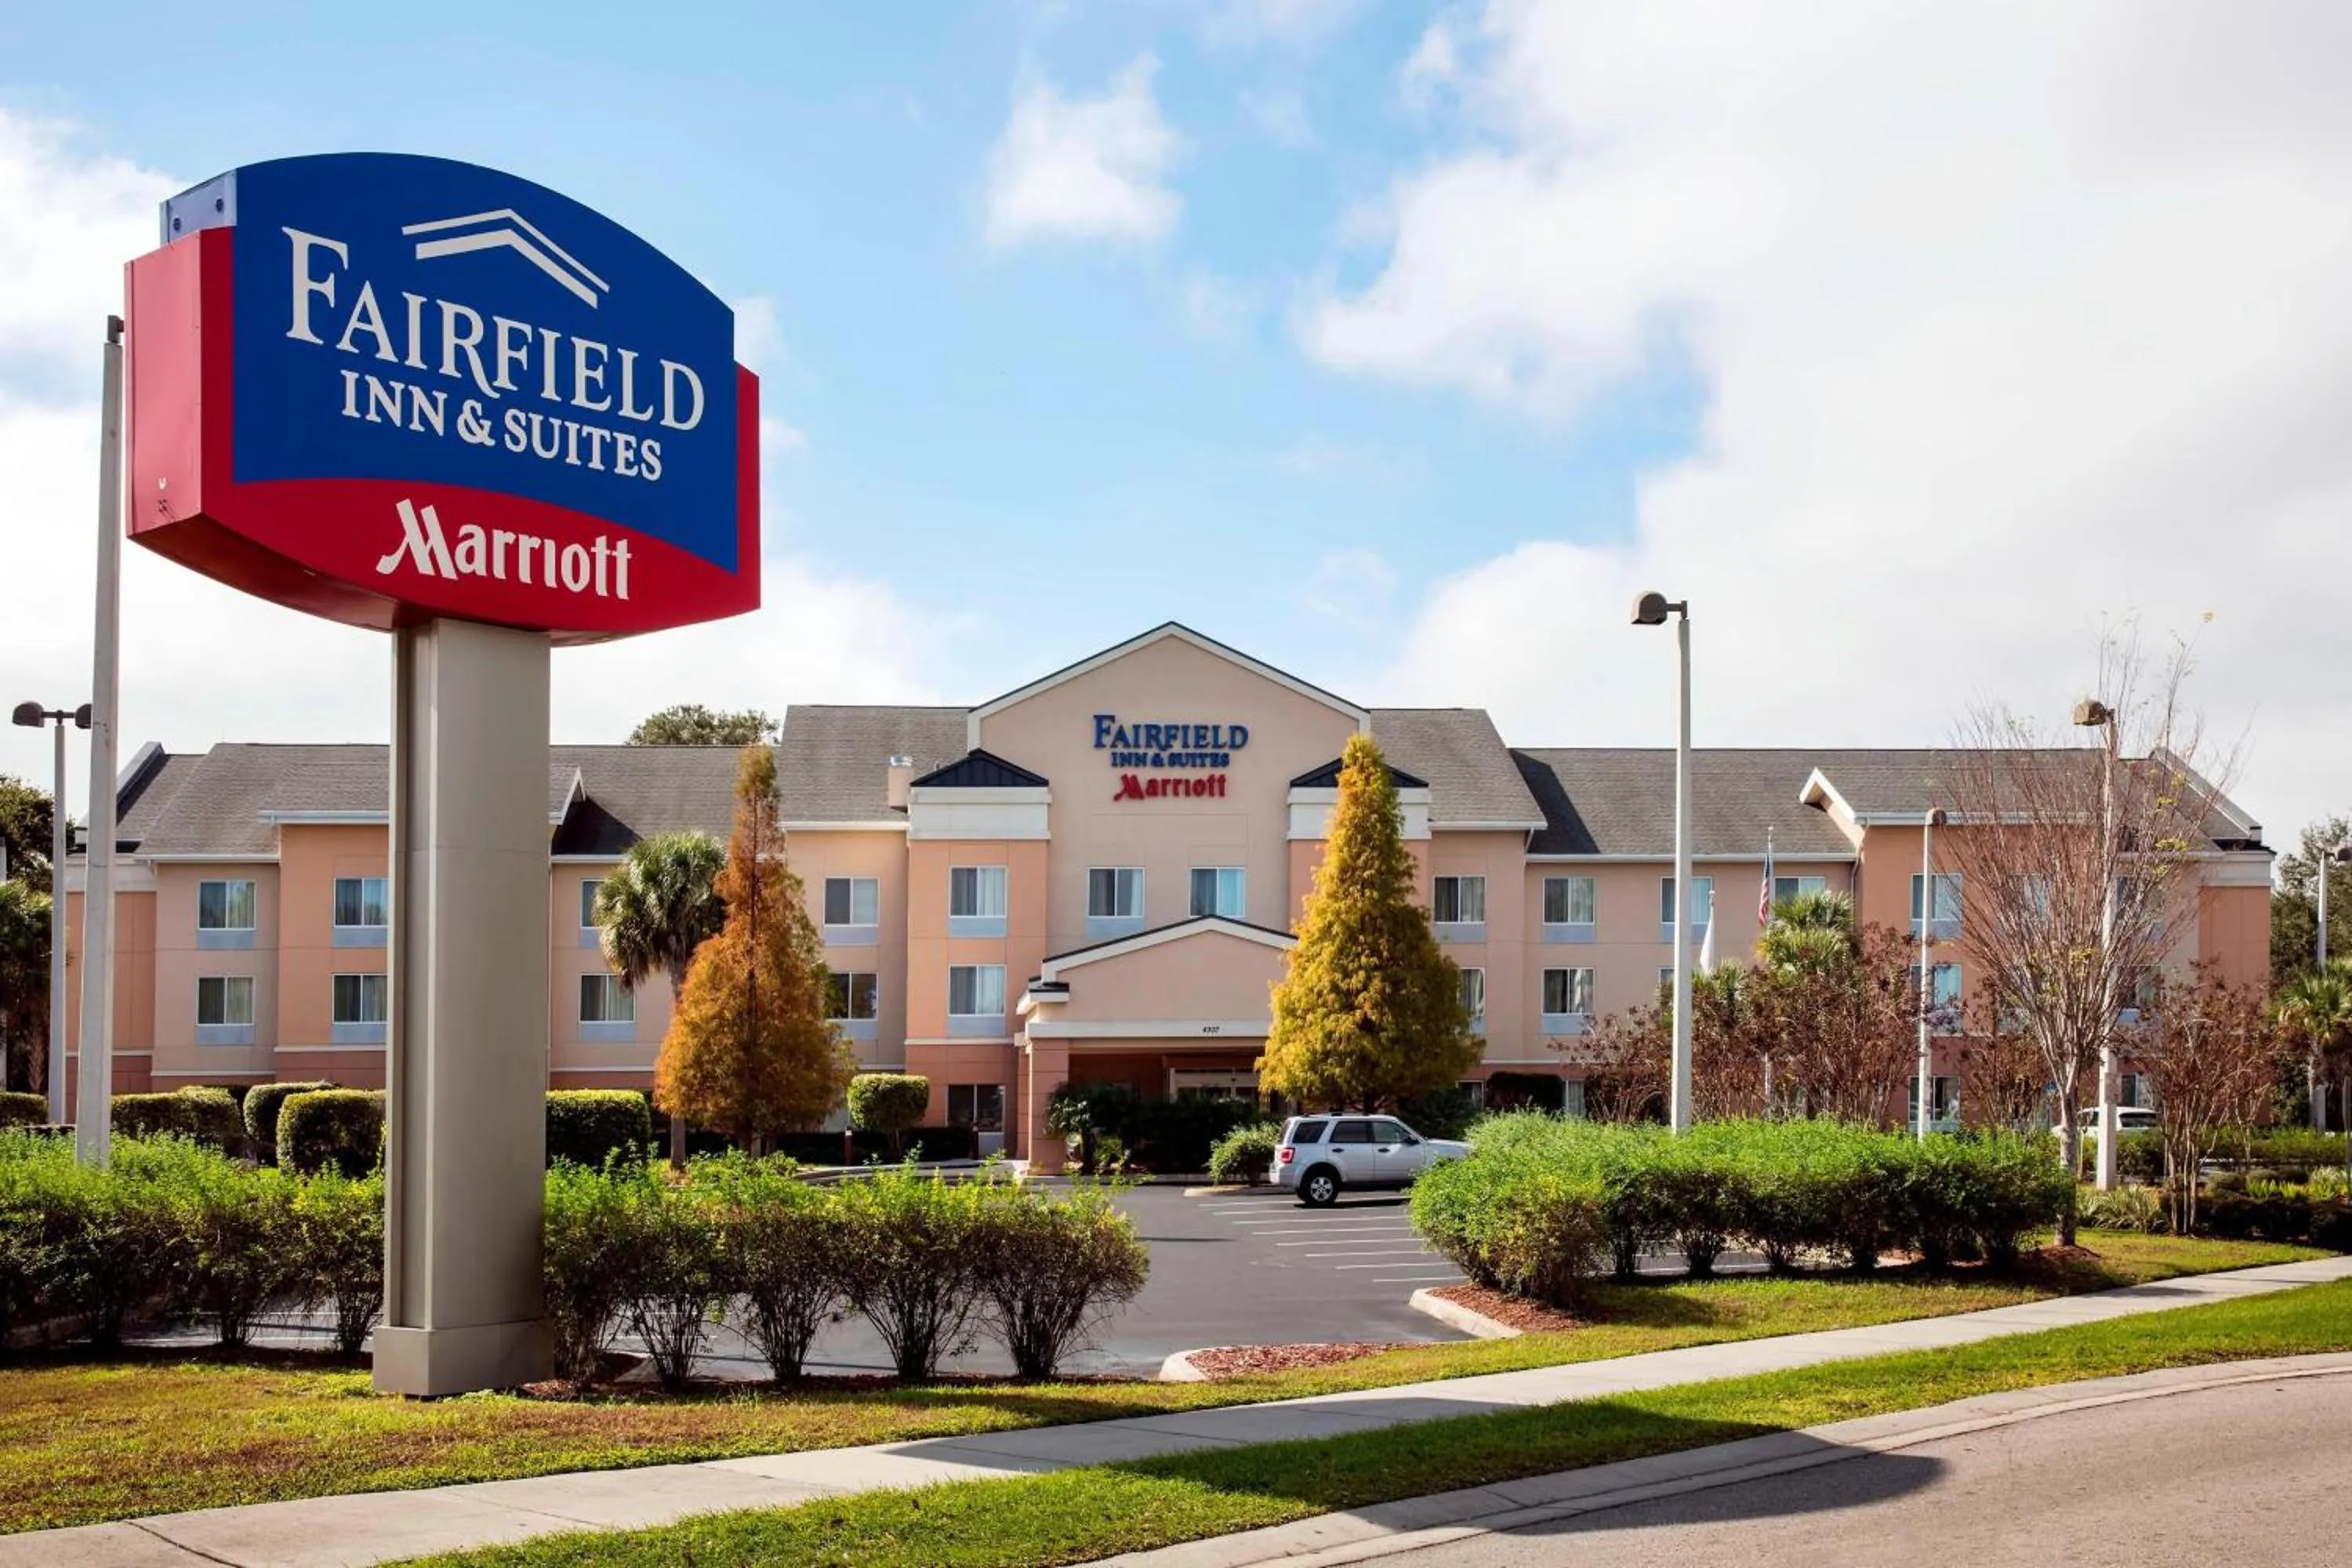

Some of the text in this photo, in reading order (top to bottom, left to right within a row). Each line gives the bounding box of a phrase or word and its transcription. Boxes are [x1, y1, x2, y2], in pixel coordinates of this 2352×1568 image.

[281, 226, 705, 430] FAIRFIELD
[341, 369, 662, 481] INN & SUITES
[376, 499, 631, 600] Marriott
[1093, 714, 1249, 751] FAIRFIELD
[1111, 753, 1230, 768] INN & SUITES
[1113, 774, 1227, 801] Marriott
